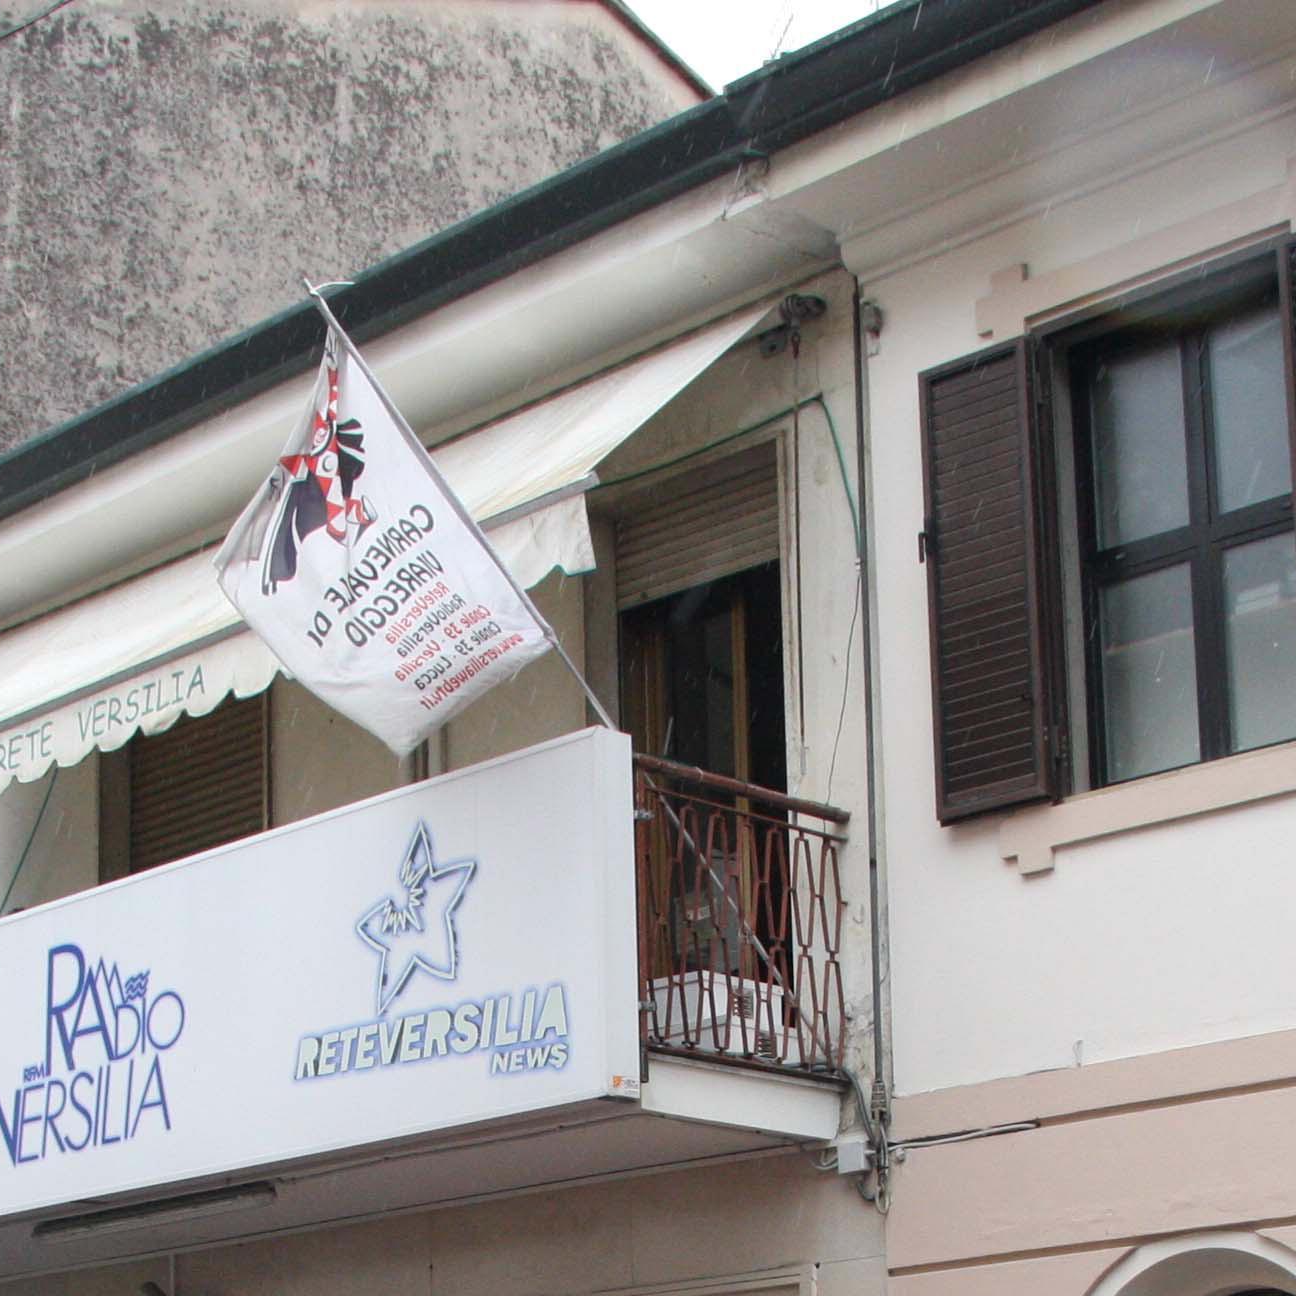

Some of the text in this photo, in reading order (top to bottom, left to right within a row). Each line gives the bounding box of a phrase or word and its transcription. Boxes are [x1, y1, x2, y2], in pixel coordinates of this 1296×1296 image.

[77, 664, 207, 742] VERSILIA
[45, 943, 185, 1076] RADIO
[294, 984, 569, 1081] RETEVERSILIA
[491, 1043, 569, 1075] NEWS
